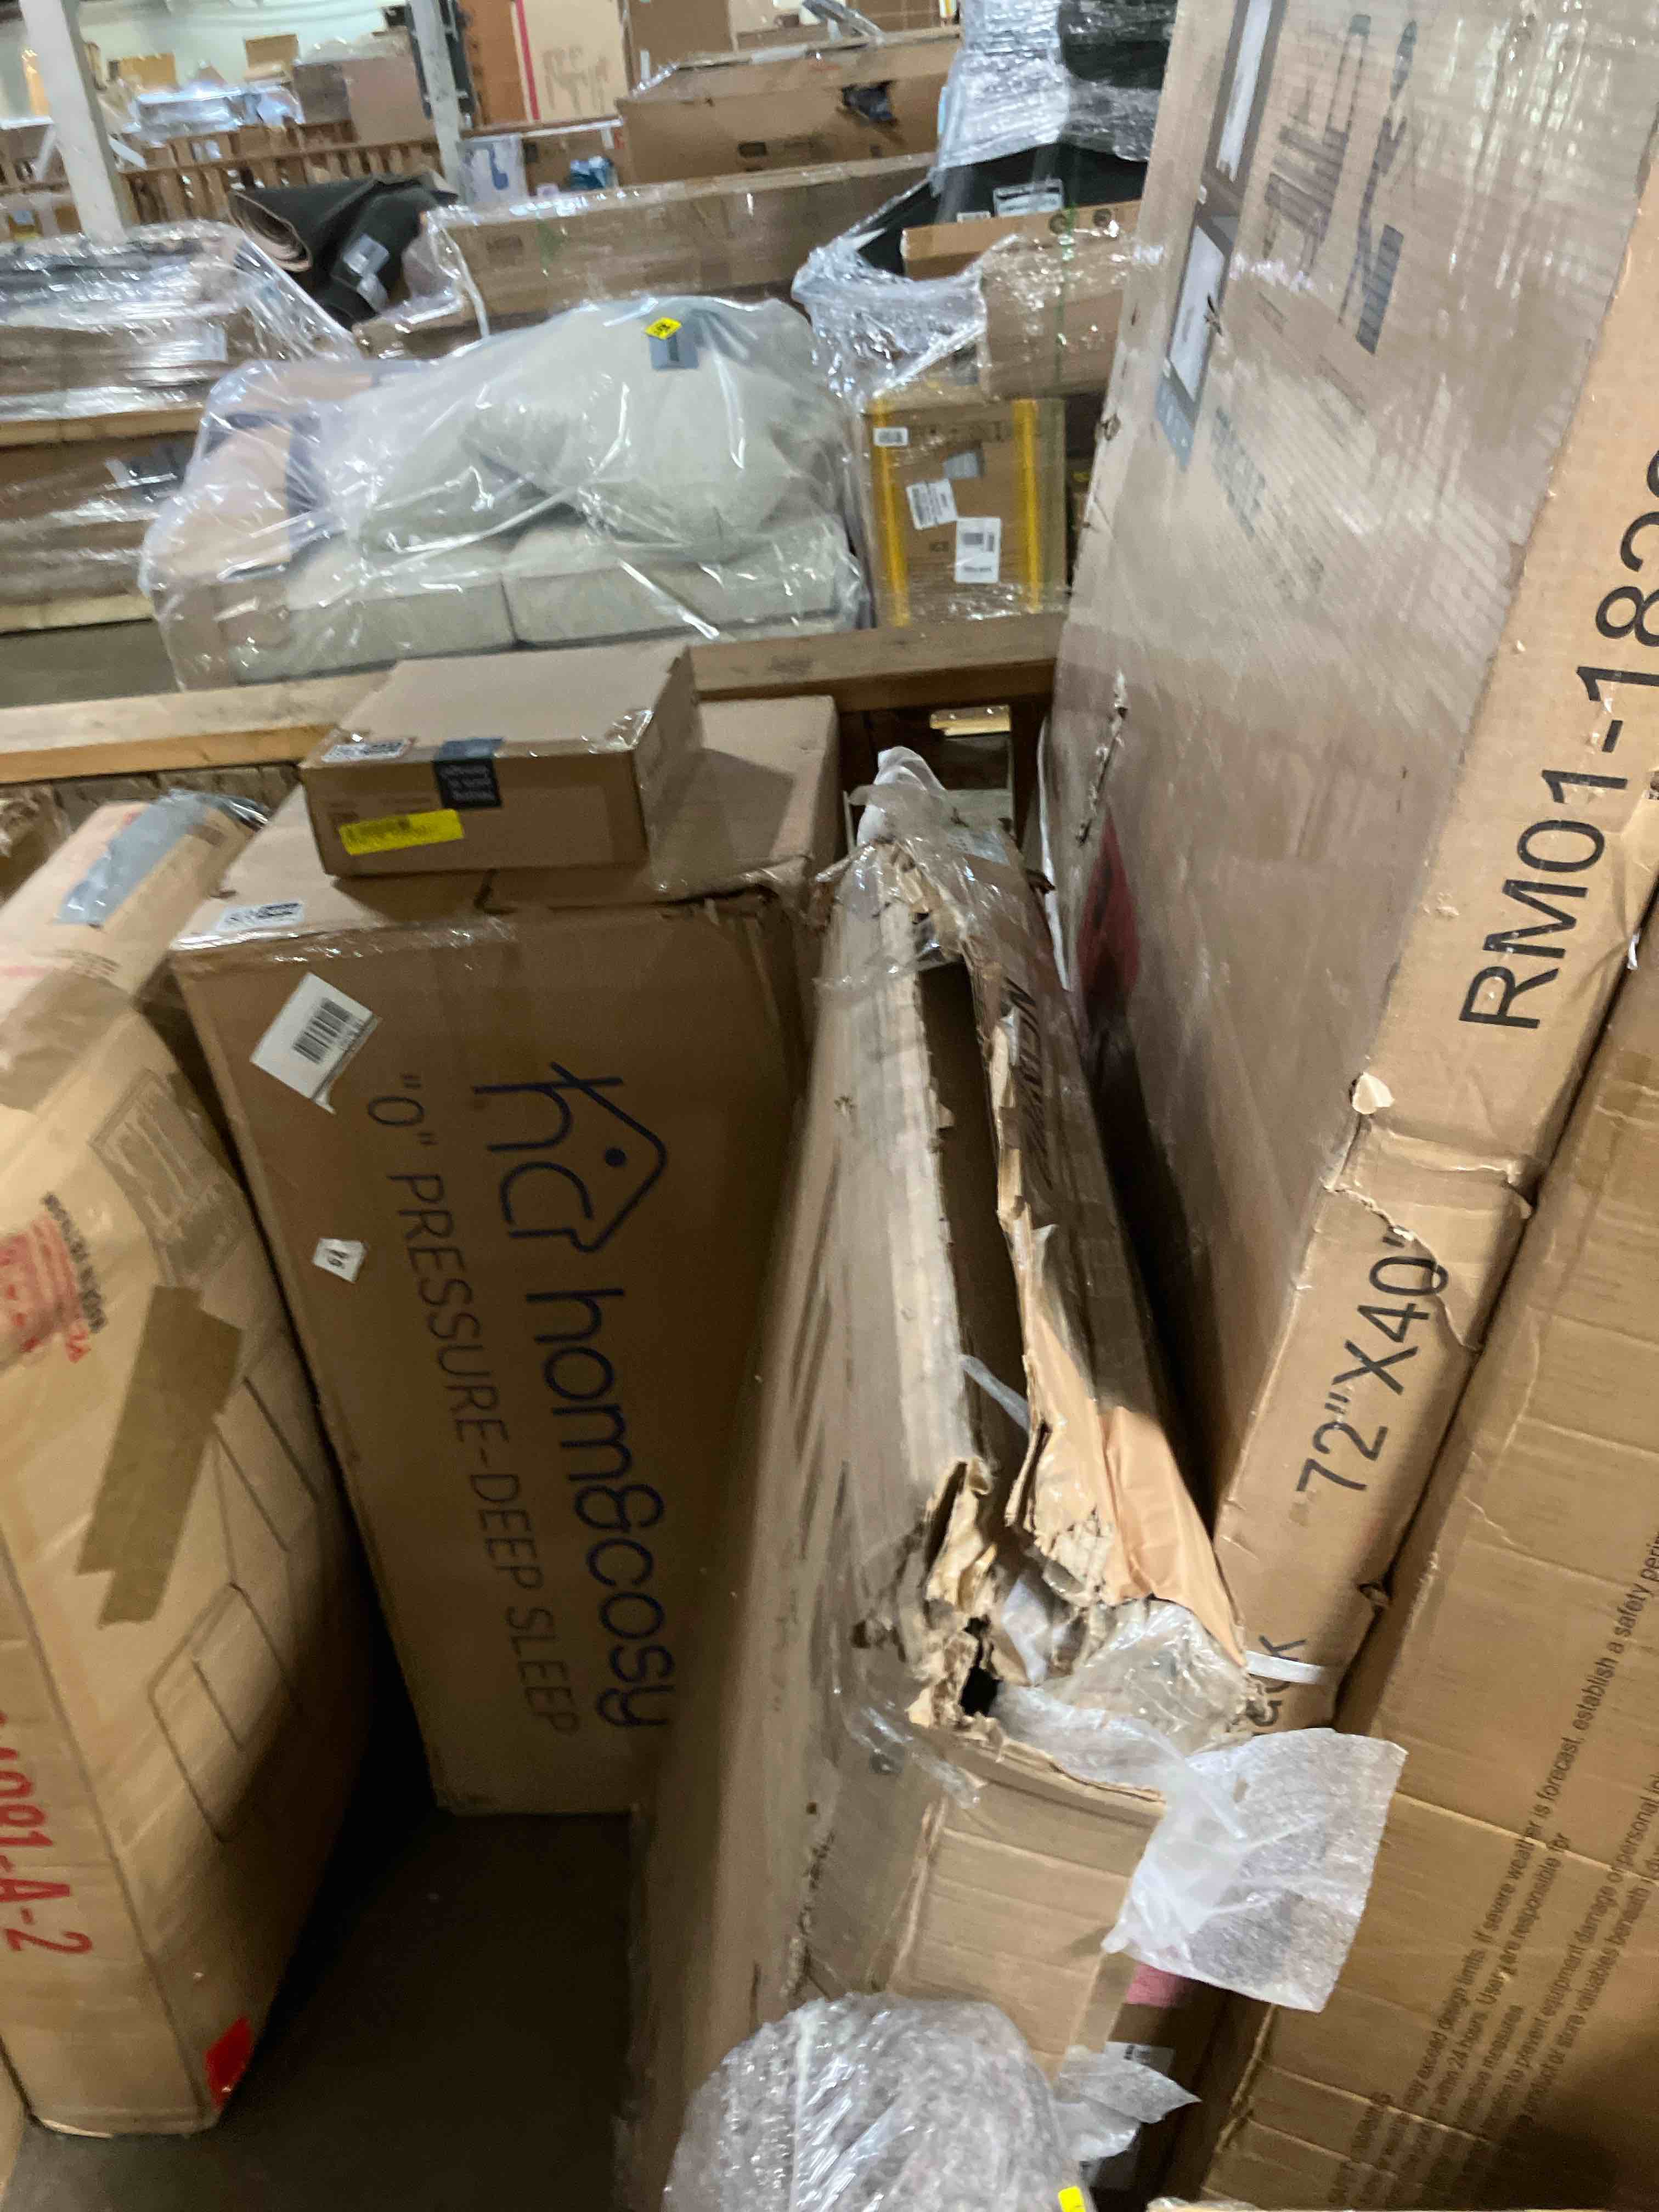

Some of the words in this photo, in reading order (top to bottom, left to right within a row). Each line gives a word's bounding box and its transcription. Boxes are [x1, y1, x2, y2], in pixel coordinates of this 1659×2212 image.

[1614, 1583, 1654, 1637] safety
[505, 1605, 581, 1737] SLEEP
[1606, 1641, 1624, 1655] a
[1573, 1657, 1616, 1730] establish
[1533, 1804, 1551, 1819] is
[1616, 1797, 1659, 1866] personal
[1547, 1832, 1570, 1852] for
